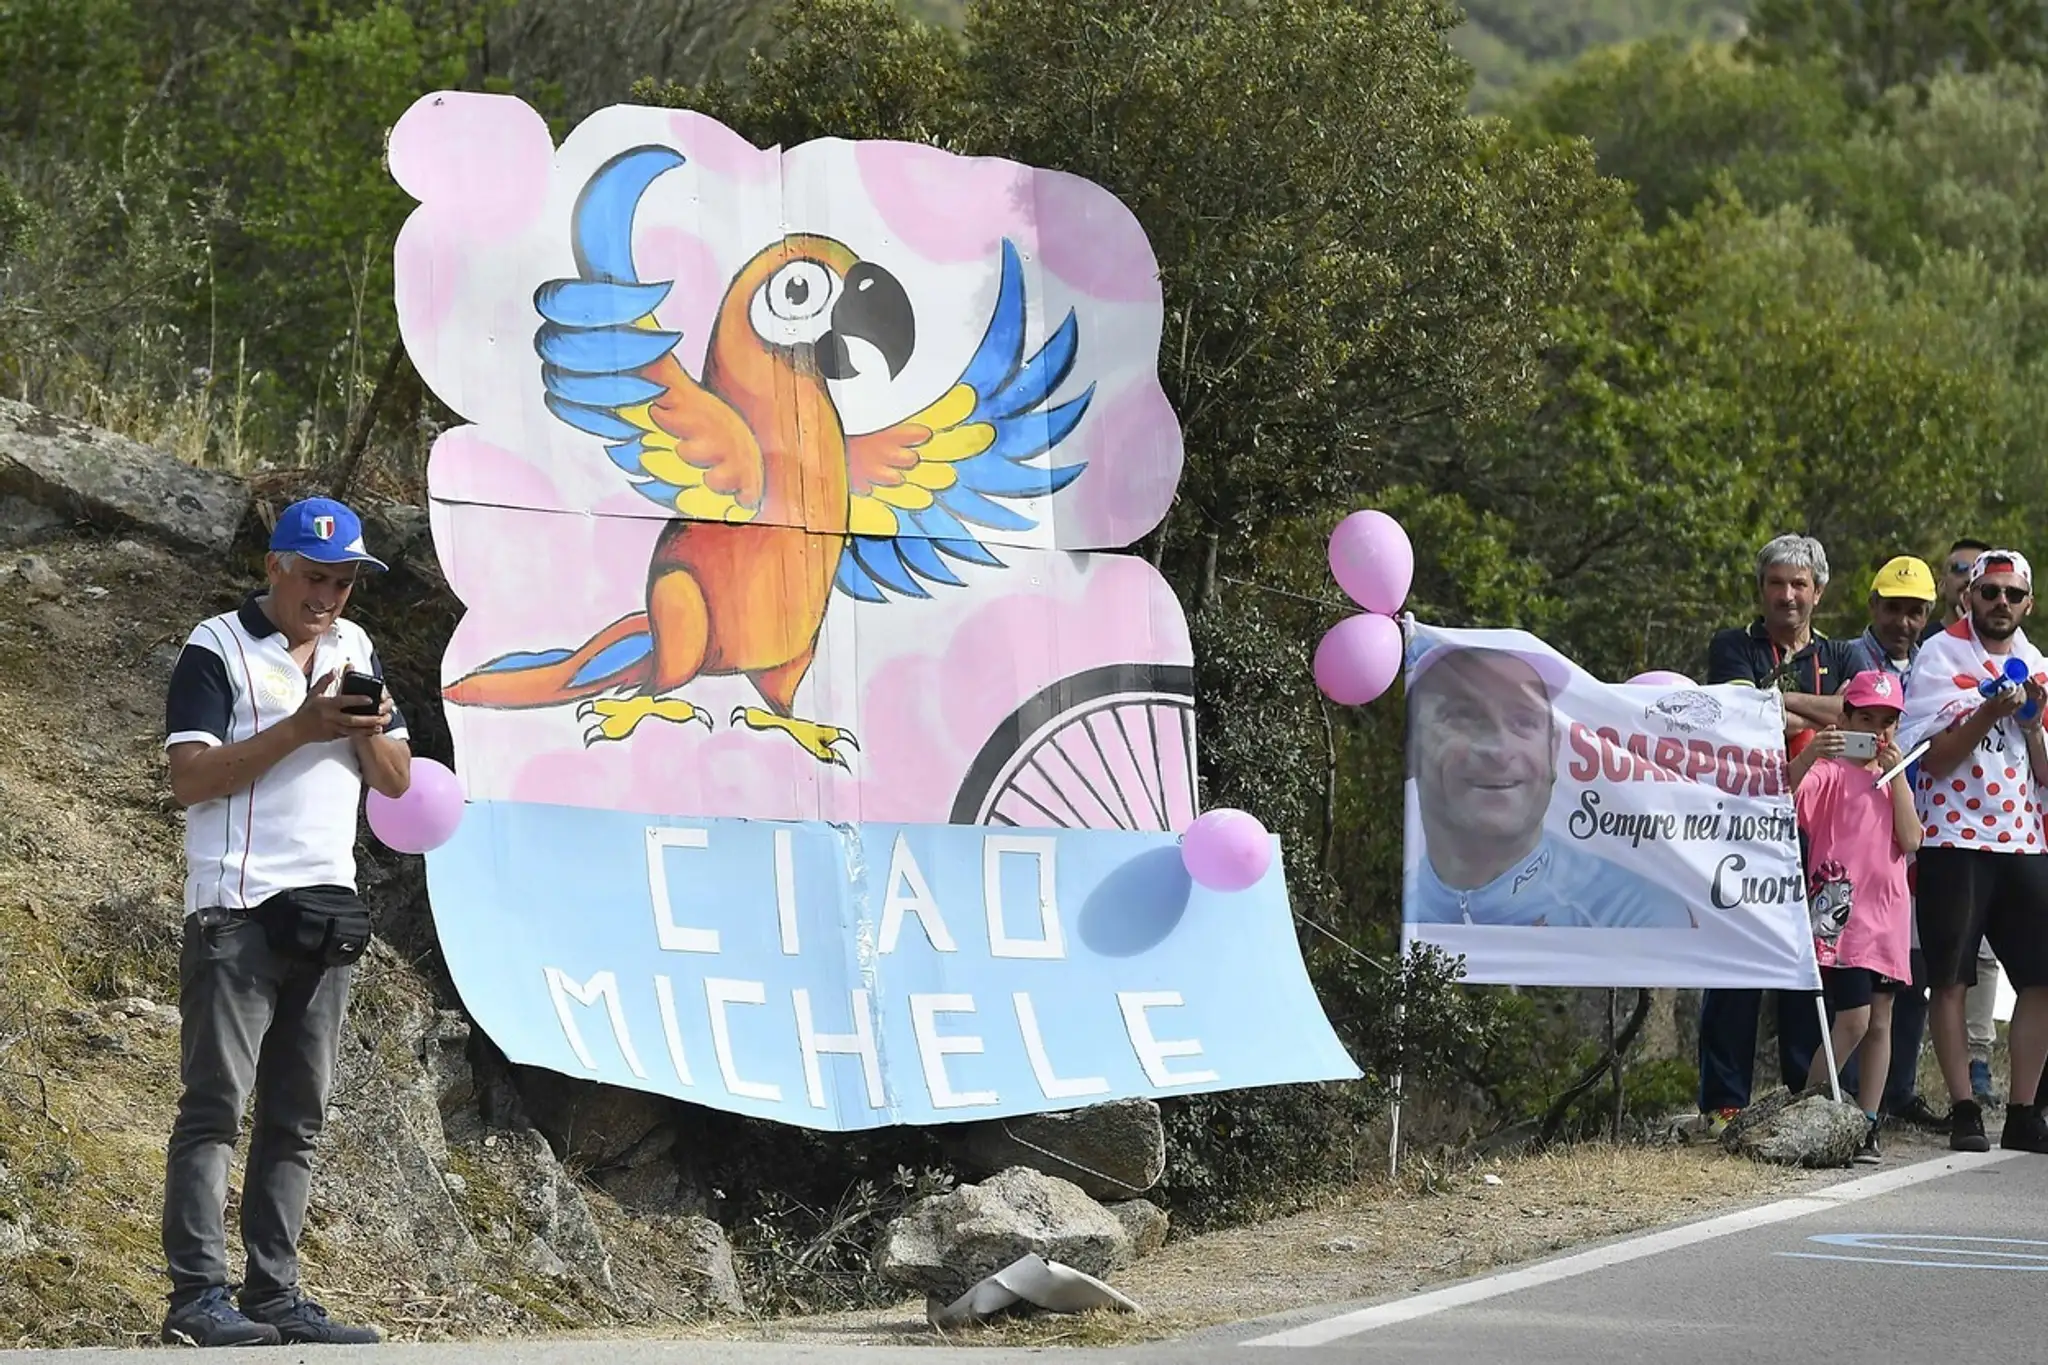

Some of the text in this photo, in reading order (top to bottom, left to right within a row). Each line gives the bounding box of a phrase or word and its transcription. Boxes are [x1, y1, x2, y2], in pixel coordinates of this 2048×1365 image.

[1569, 789, 1797, 848] Sempre nei nostri
[646, 827, 1066, 960] CIAO
[1710, 853, 1805, 910] Cuori
[544, 967, 1220, 1110] MICHELE
